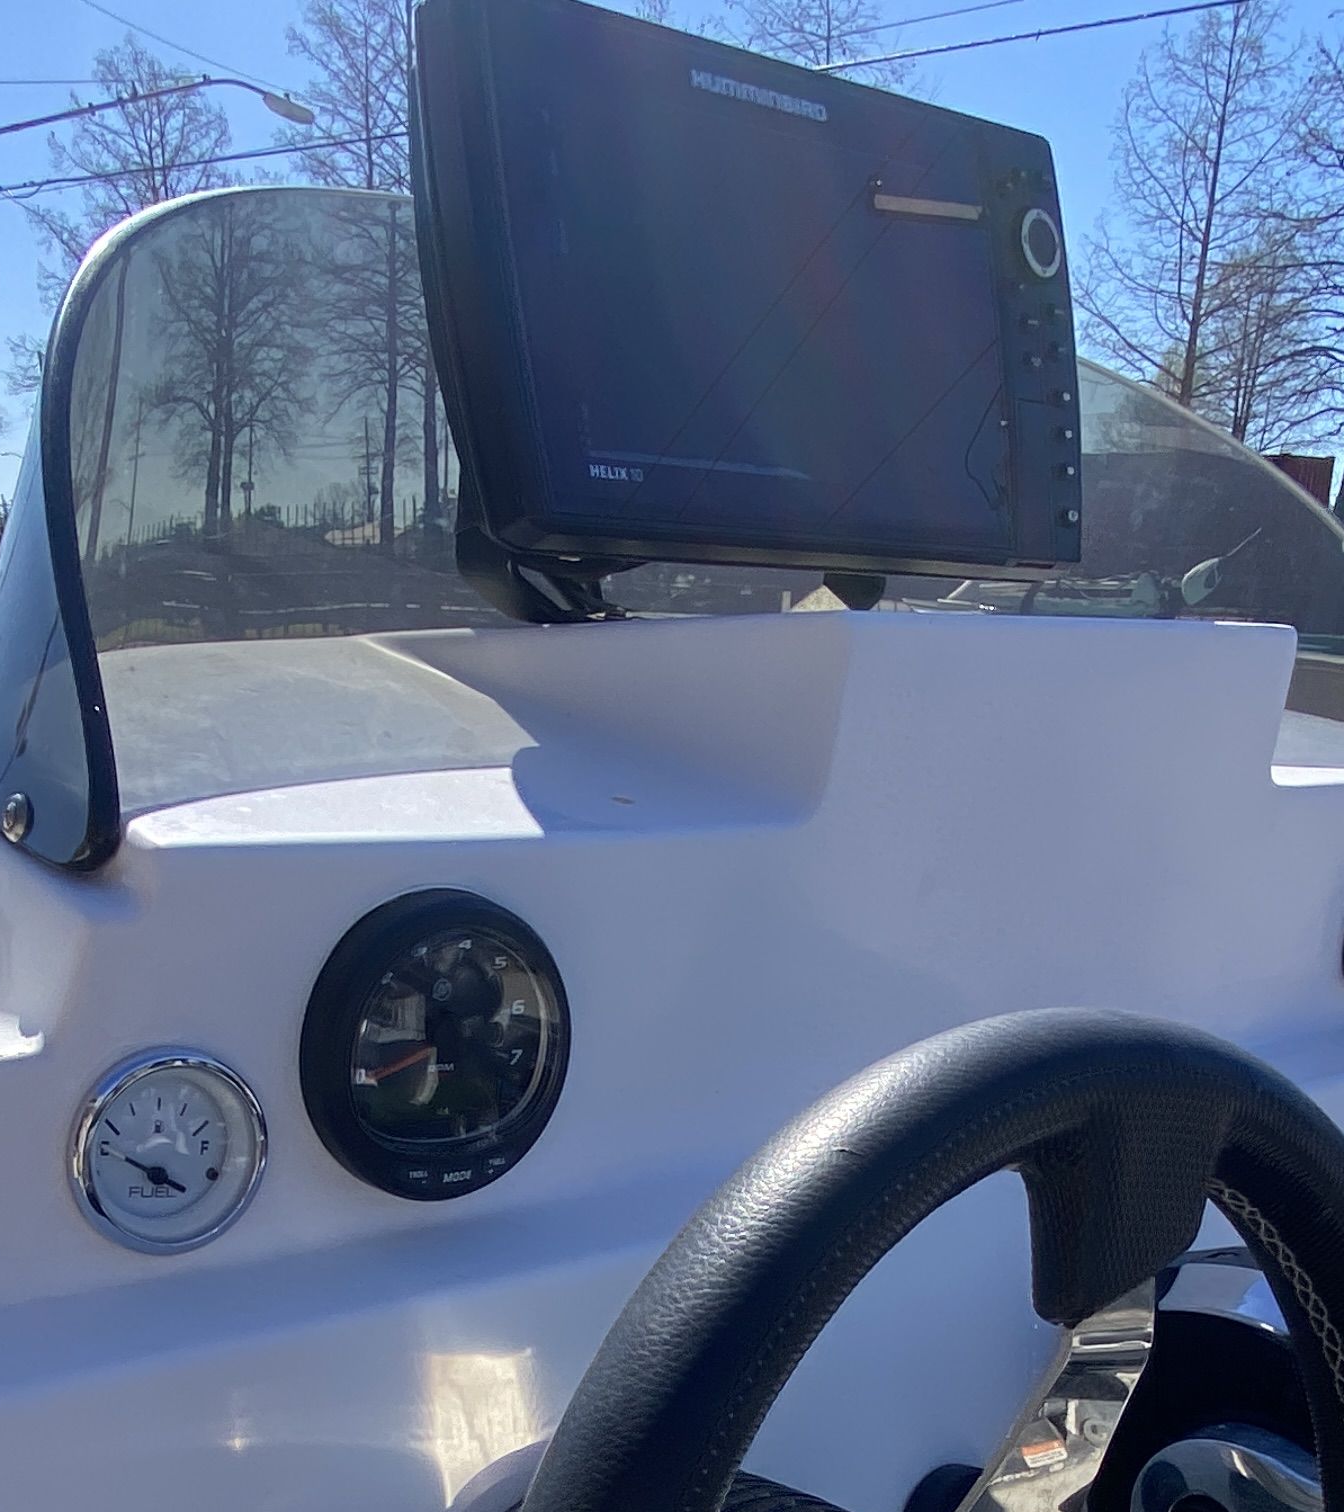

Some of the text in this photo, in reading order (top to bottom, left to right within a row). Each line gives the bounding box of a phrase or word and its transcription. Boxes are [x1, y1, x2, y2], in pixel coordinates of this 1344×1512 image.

[589, 464, 628, 481] HELIX
[458, 939, 472, 950] 4
[493, 956, 508, 969] 5
[511, 1000, 526, 1015] 6
[509, 1049, 523, 1066] 7
[100, 1140, 110, 1156] E
[200, 1140, 209, 1155] F
[442, 1169, 472, 1183] MODE
[128, 1186, 177, 1198] FUEL
